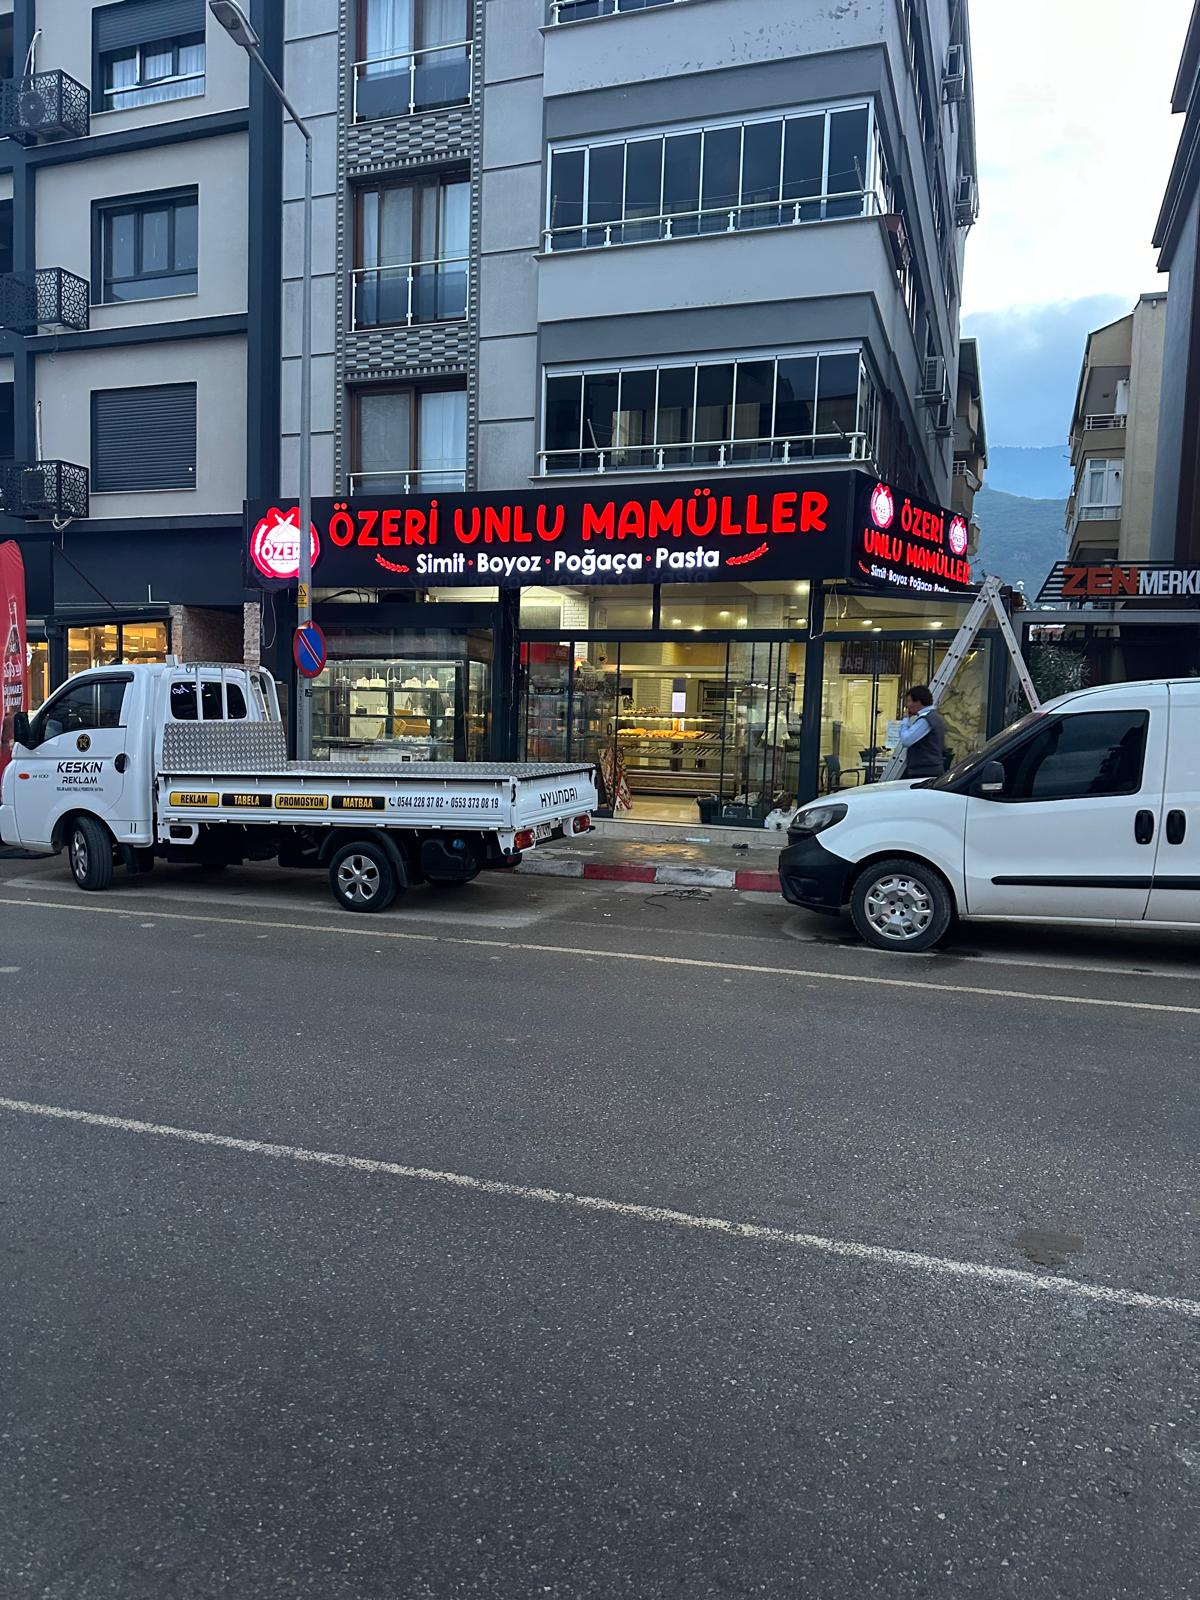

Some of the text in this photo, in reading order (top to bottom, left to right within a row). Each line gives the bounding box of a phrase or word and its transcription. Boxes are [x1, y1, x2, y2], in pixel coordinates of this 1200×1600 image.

[328, 488, 828, 546] ÖZERİ UNLU MAMÜLLER
[901, 498, 944, 544] ÖZERİ
[261, 540, 300, 561] ÖZER
[416, 545, 720, 577] Simit Boyoz Poğaça Pasta
[864, 527, 970, 585] UNLU MAMÜLLER
[871, 564, 886, 579] Simit
[888, 570, 907, 586] Boyoz
[1062, 567, 1138, 594] ZEN
[62, 776, 98, 784] REKLAM
[180, 794, 208, 804] REKLAM
[234, 795, 260, 806] TABELA
[279, 796, 324, 807] PROMOSYON
[342, 797, 373, 808] MATBAA
[397, 796, 499, 809] 0544 228 37 82 0553 373 08 19
[540, 787, 578, 808] HYUNDAI
